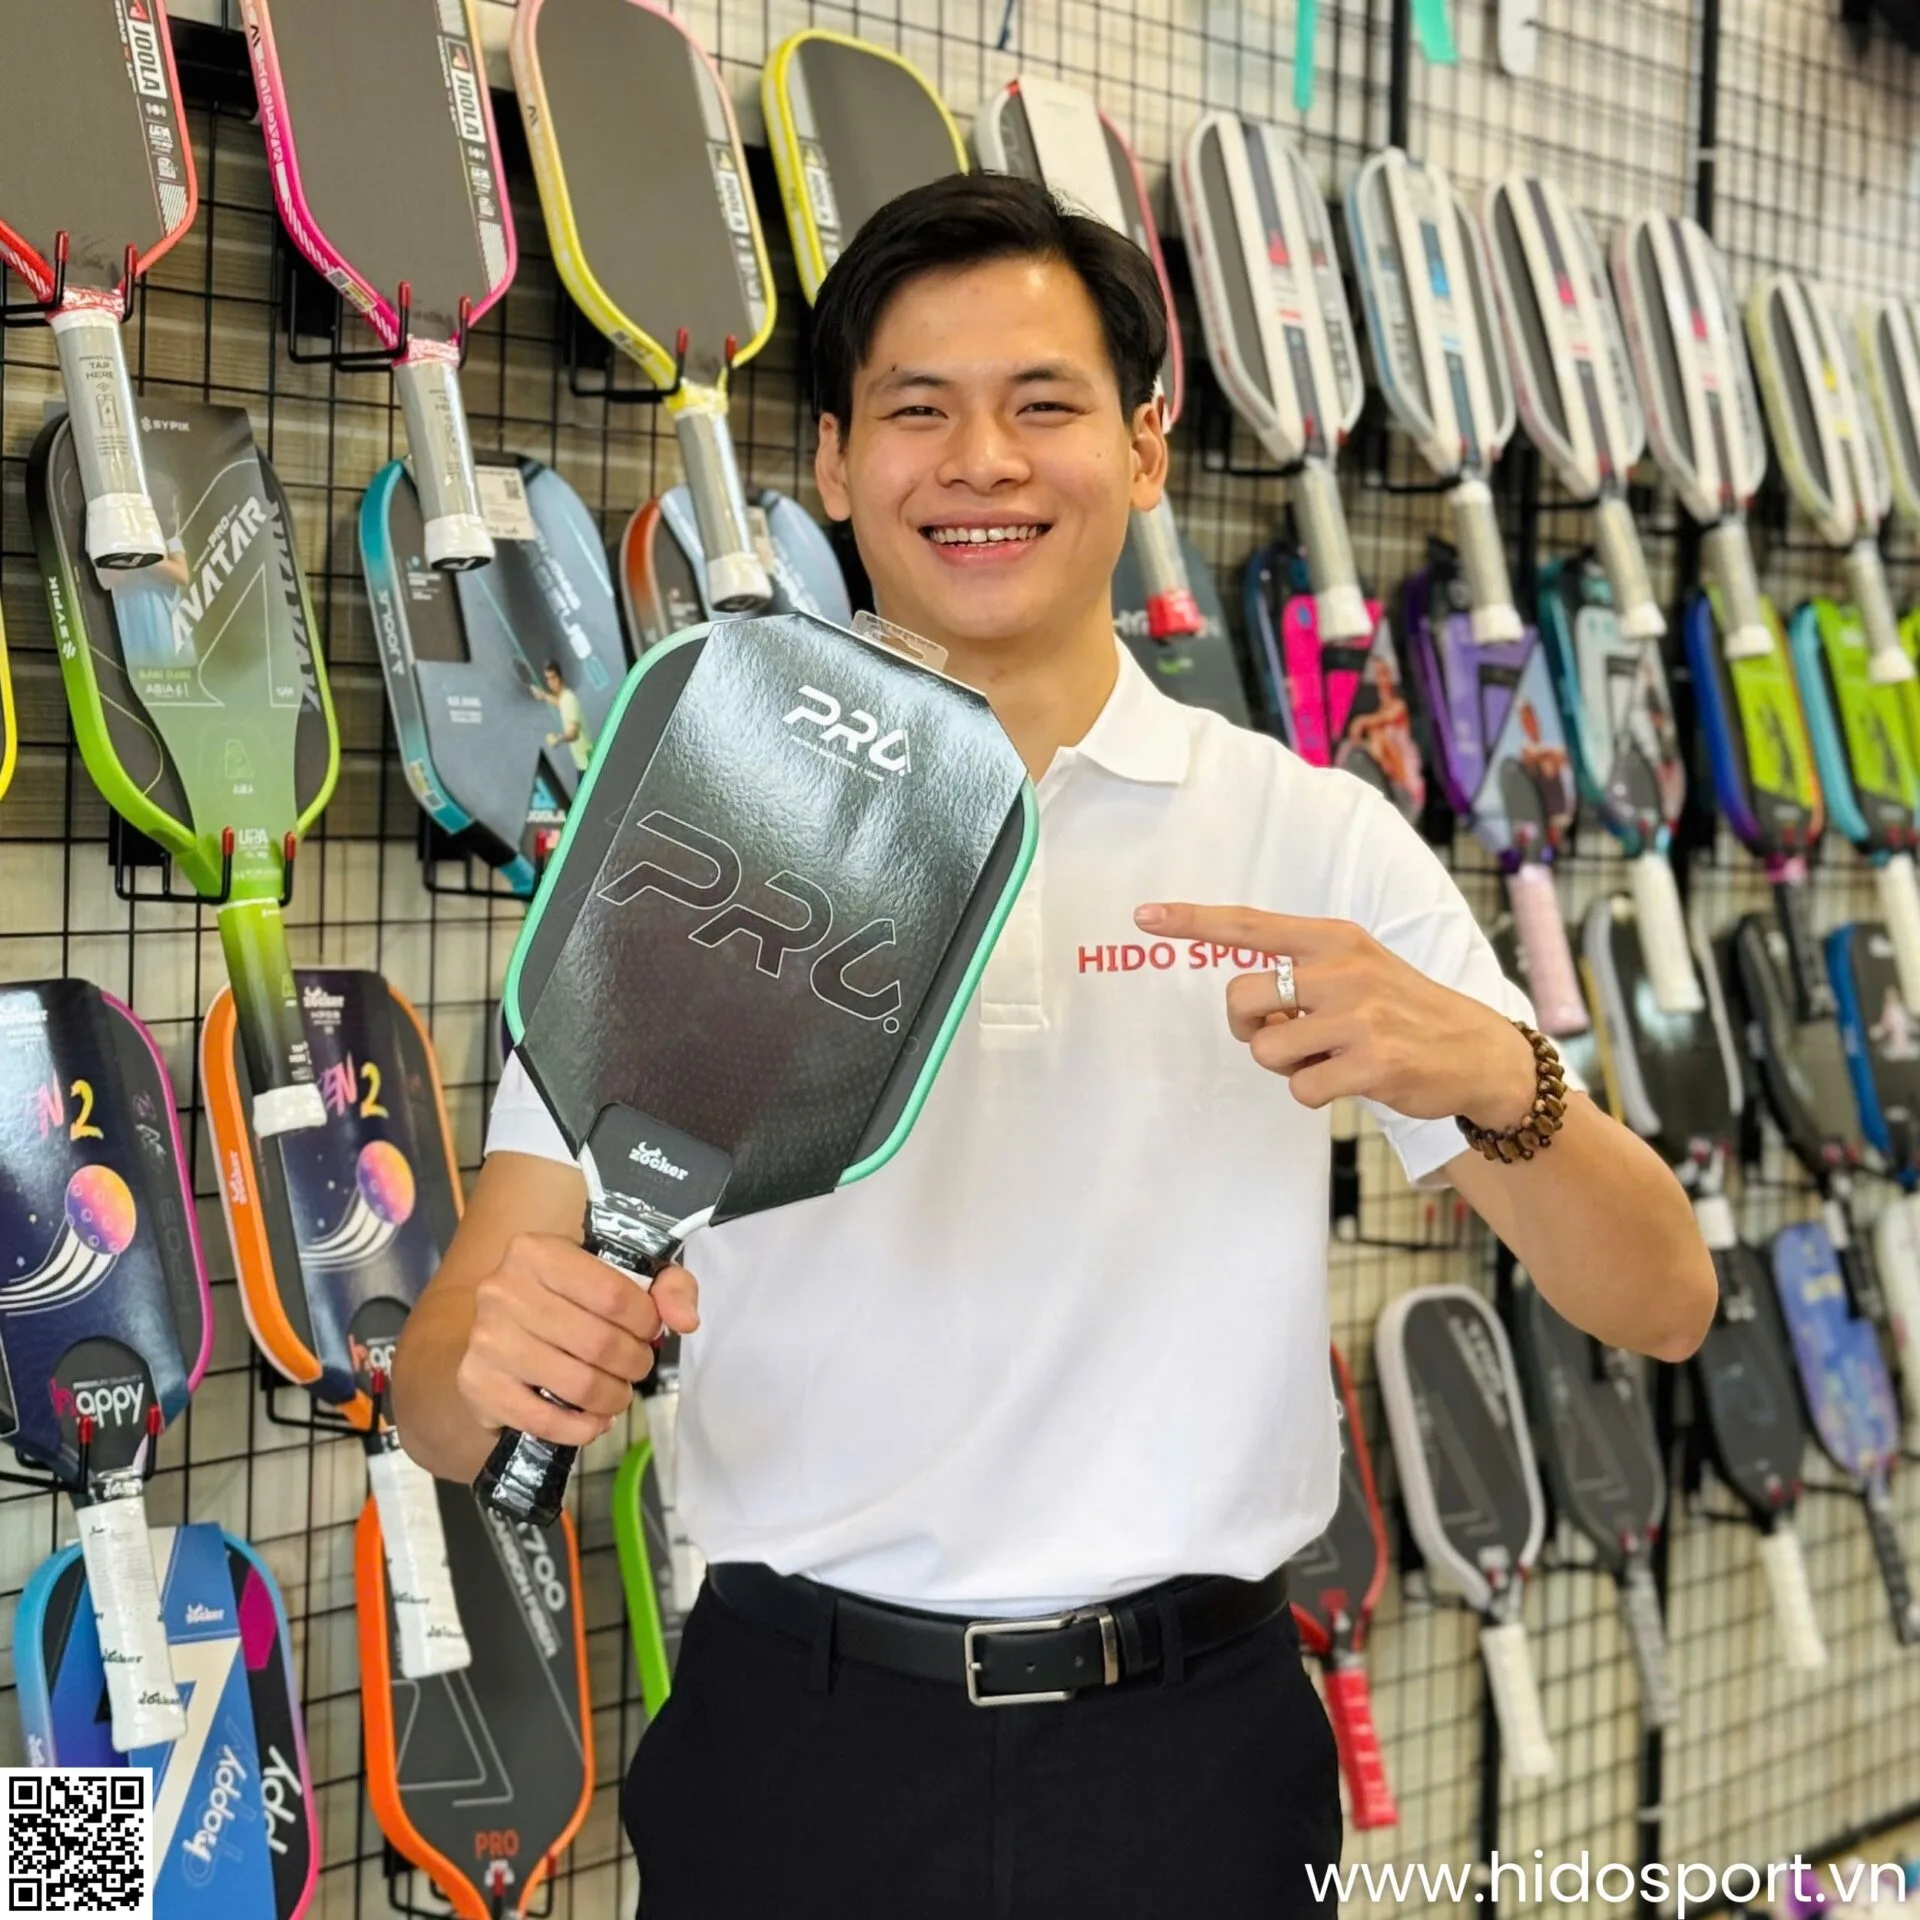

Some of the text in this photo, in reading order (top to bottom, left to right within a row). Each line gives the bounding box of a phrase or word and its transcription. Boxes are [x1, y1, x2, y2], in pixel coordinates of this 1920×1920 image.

[132, 25, 161, 92] JOOLA
[455, 74, 480, 136] JOOLA
[206, 515, 231, 549] PRO
[171, 496, 269, 657] AVATAR
[376, 589, 402, 658] JOOLA
[1078, 942, 1290, 974] HIDO SPOR
[70, 1079, 105, 1142] 2
[360, 1061, 390, 1119] 2
[629, 1146, 689, 1181] zocker
[47, 1376, 145, 1429] happy
[181, 1743, 248, 1862] happy
[474, 1829, 520, 1860] PRO
